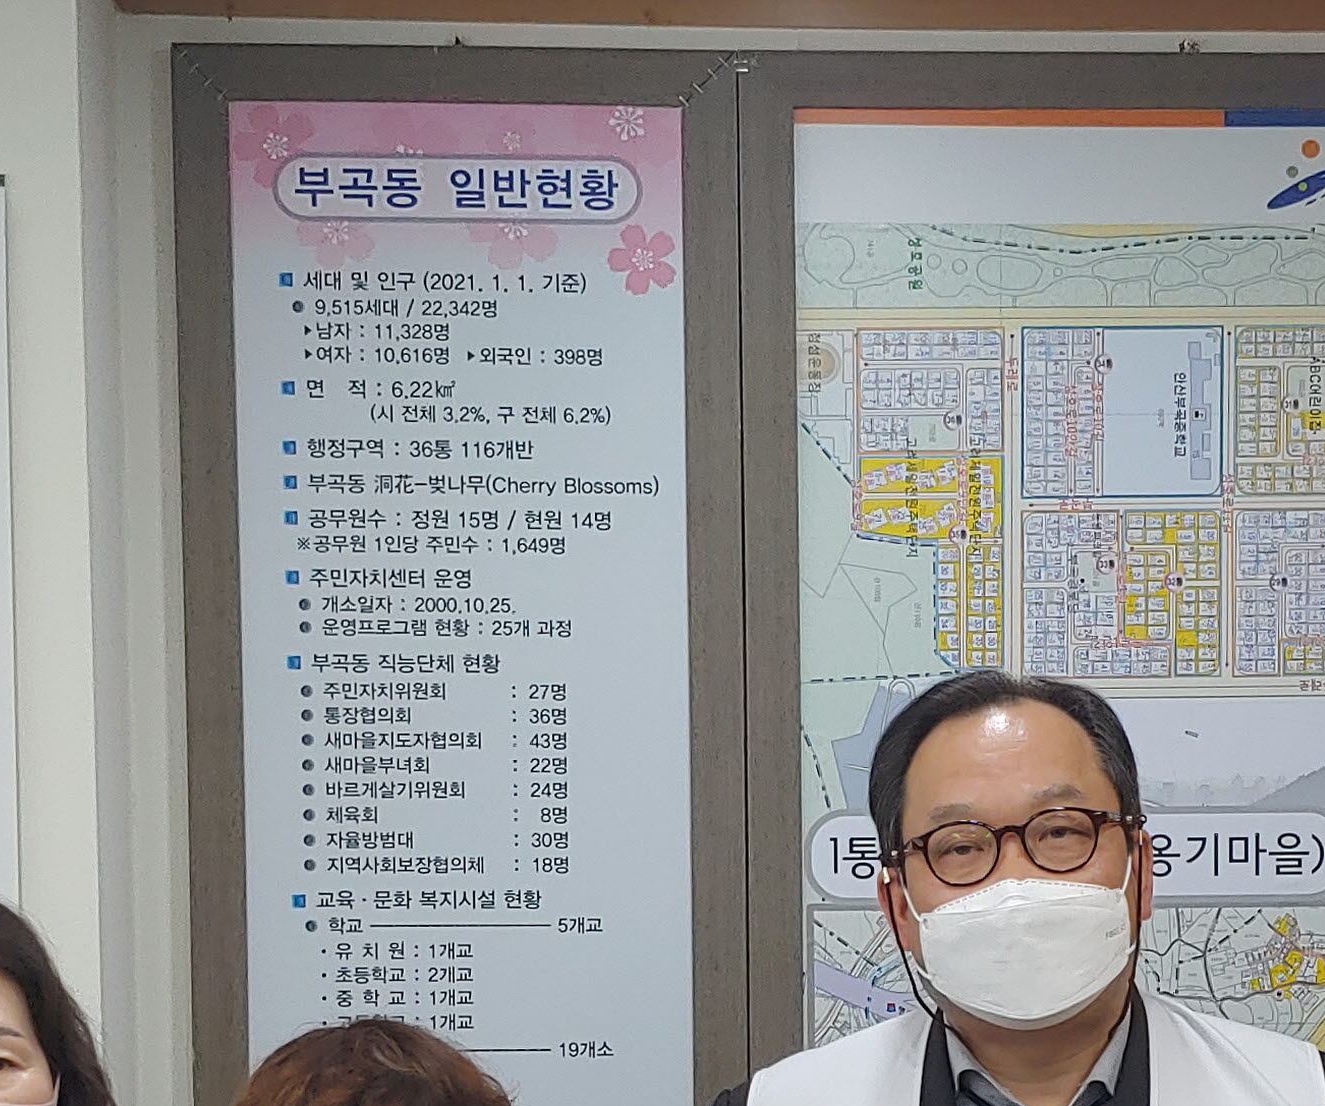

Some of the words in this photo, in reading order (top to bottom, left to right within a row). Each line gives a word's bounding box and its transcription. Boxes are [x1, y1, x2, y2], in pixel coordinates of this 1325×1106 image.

[295, 167, 421, 208] 부곡동
[451, 169, 618, 210] 일반현황
[304, 271, 341, 290] 세대
[351, 271, 367, 290] 및
[378, 272, 415, 291] 인구
[424, 271, 482, 292] (2021.
[493, 275, 507, 292] 1.
[519, 275, 533, 292] 1.
[543, 273, 586, 294] 기준)
[315, 299, 398, 316] 9,515세대
[422, 300, 497, 318] 22,342명
[317, 322, 349, 340] 남자
[375, 323, 449, 341] 11,328명
[317, 346, 351, 363] 여자
[376, 347, 449, 364] 10,616명
[480, 348, 530, 365] 외국인
[554, 349, 602, 366] 398명
[307, 380, 324, 398] 면
[349, 380, 365, 399] 적
[371, 404, 393, 422] (시
[402, 405, 435, 422] 전체
[443, 406, 489, 424] 3.2%,
[498, 407, 514, 424] 구
[523, 406, 555, 424] 전체
[564, 406, 610, 425] 6.2%)
[307, 439, 383, 458] 행정구역
[410, 440, 452, 459] 36통
[462, 440, 533, 459] 116개반
[308, 474, 365, 494] 부곡동
[565, 476, 658, 496] Blossoms)
[309, 509, 386, 528] 공무원수
[412, 510, 448, 529] 정원
[459, 511, 498, 529] 15명
[525, 511, 561, 530] 현원
[572, 511, 610, 530] 14명
[375, 536, 418, 553] 1인당
[426, 536, 478, 553] 주민수
[503, 537, 565, 555] 1,649명
[310, 569, 424, 588] 주민자치센터
[434, 569, 471, 588] 운영
[322, 596, 392, 613] 개소일자
[415, 597, 515, 614] 2000.10.25.
[323, 619, 426, 636] 운영프로그램
[435, 619, 469, 637] 현황
[492, 620, 529, 637] 25개
[538, 620, 571, 637] 과정
[312, 654, 370, 673] 부곡동
[379, 654, 454, 673] 직능단체
[463, 654, 500, 673] 현황
[323, 683, 445, 700] 주민자치위원회
[529, 684, 566, 701] 27명
[324, 707, 410, 724] 통장협의회
[530, 708, 566, 725] 36명
[325, 732, 481, 749] 새마을지도자협의회
[530, 732, 566, 750] 43명
[325, 757, 429, 774] 새마을부녀회
[531, 757, 567, 774] 22명
[326, 781, 464, 799] 바르게살기위원회
[531, 782, 567, 799] 24명
[326, 807, 377, 824] 체육회
[541, 807, 567, 824] 8명
[327, 832, 413, 849] 자율방범대
[532, 832, 568, 849] 30명
[328, 857, 483, 874] 지역사회보장협의체
[533, 857, 568, 874] 18명
[317, 891, 354, 909] 교육
[374, 891, 412, 909] 문화
[419, 890, 494, 909] 복지시설
[504, 890, 541, 909] 현황
[329, 917, 363, 934] 학교
[558, 917, 603, 933] 5개교
[430, 942, 473, 959] 1개교
[336, 967, 406, 984] 초등학교
[429, 967, 473, 983] 2개교
[430, 989, 473, 1006] 1개교
[430, 1014, 474, 1031] 1개교
[560, 1041, 613, 1058] 19개소
